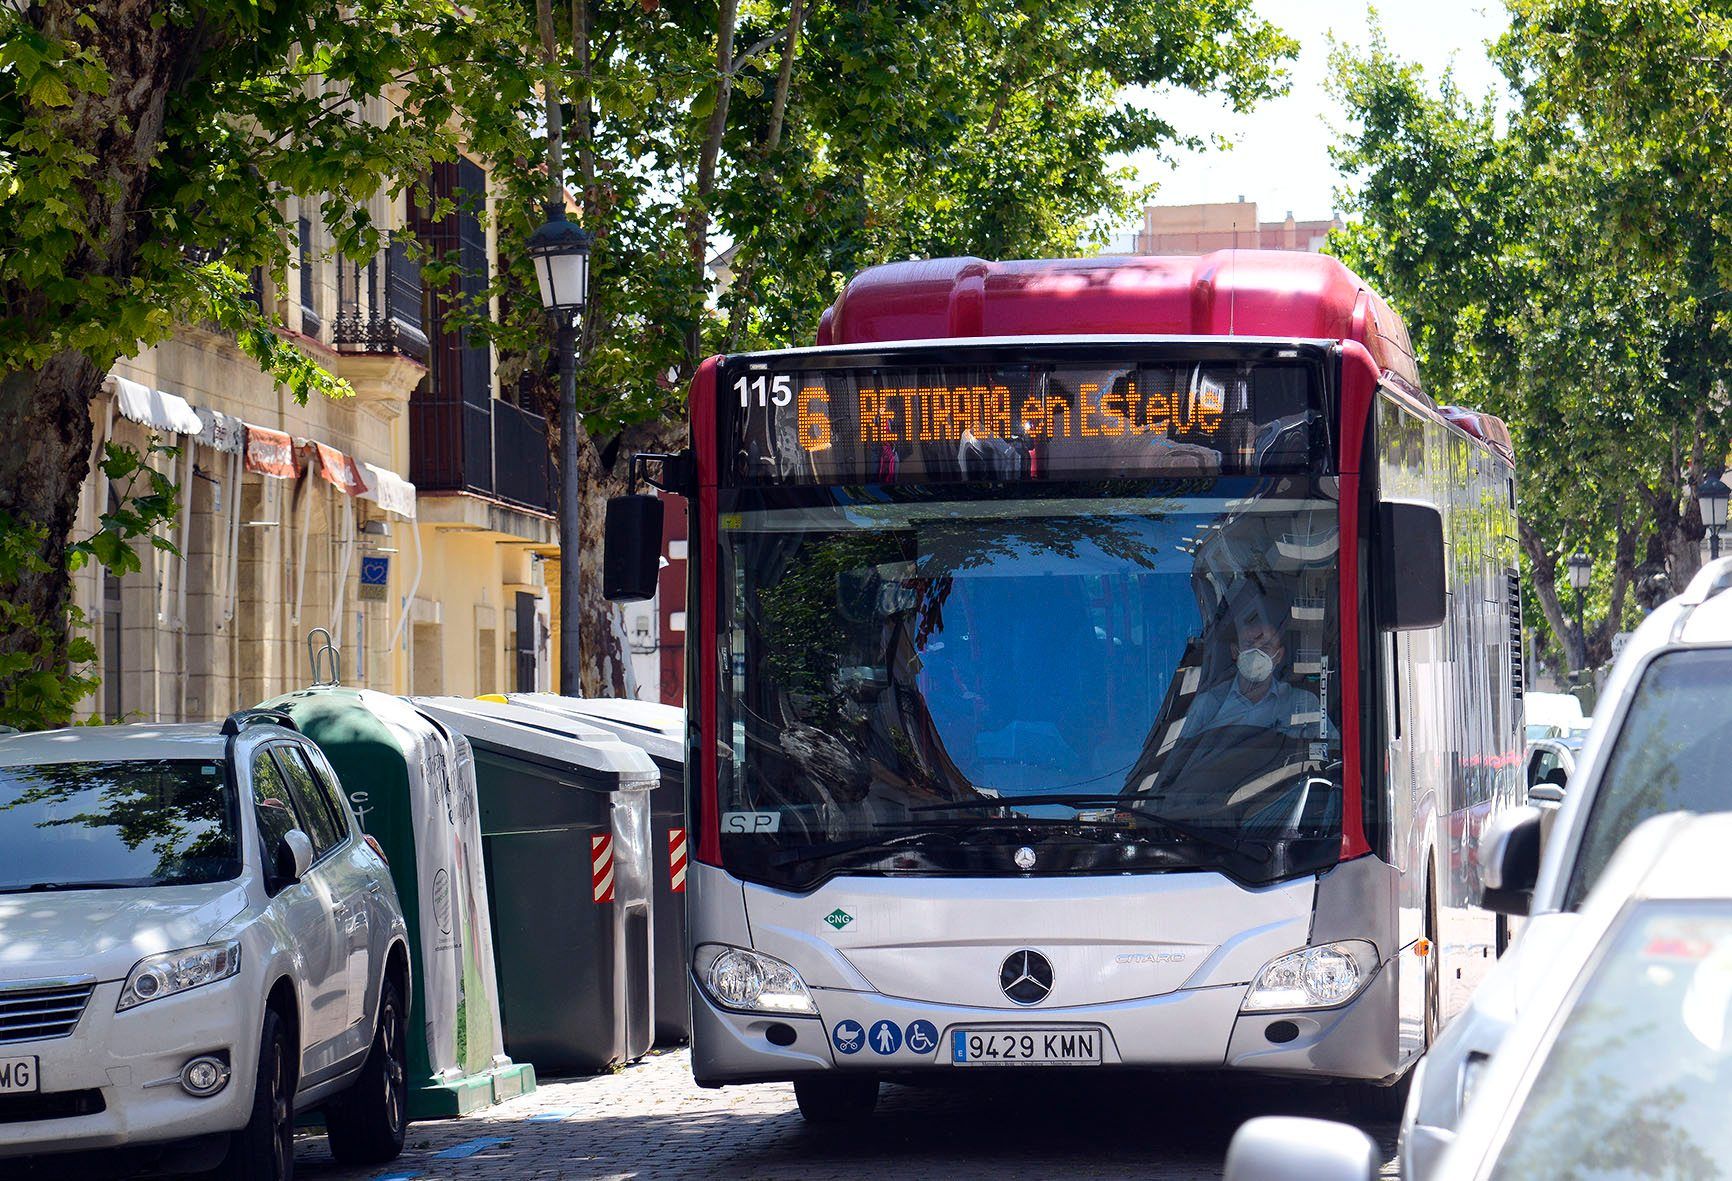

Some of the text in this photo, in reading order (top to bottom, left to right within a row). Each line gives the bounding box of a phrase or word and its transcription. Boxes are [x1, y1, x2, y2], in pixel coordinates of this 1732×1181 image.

[733, 375, 792, 408] 115
[798, 382, 1223, 452] 6 RETIRADA en Esteve
[728, 814, 773, 833] SP
[827, 914, 850, 924] CNG
[969, 1035, 1034, 1059] 9429
[1044, 1034, 1093, 1058] KMN
